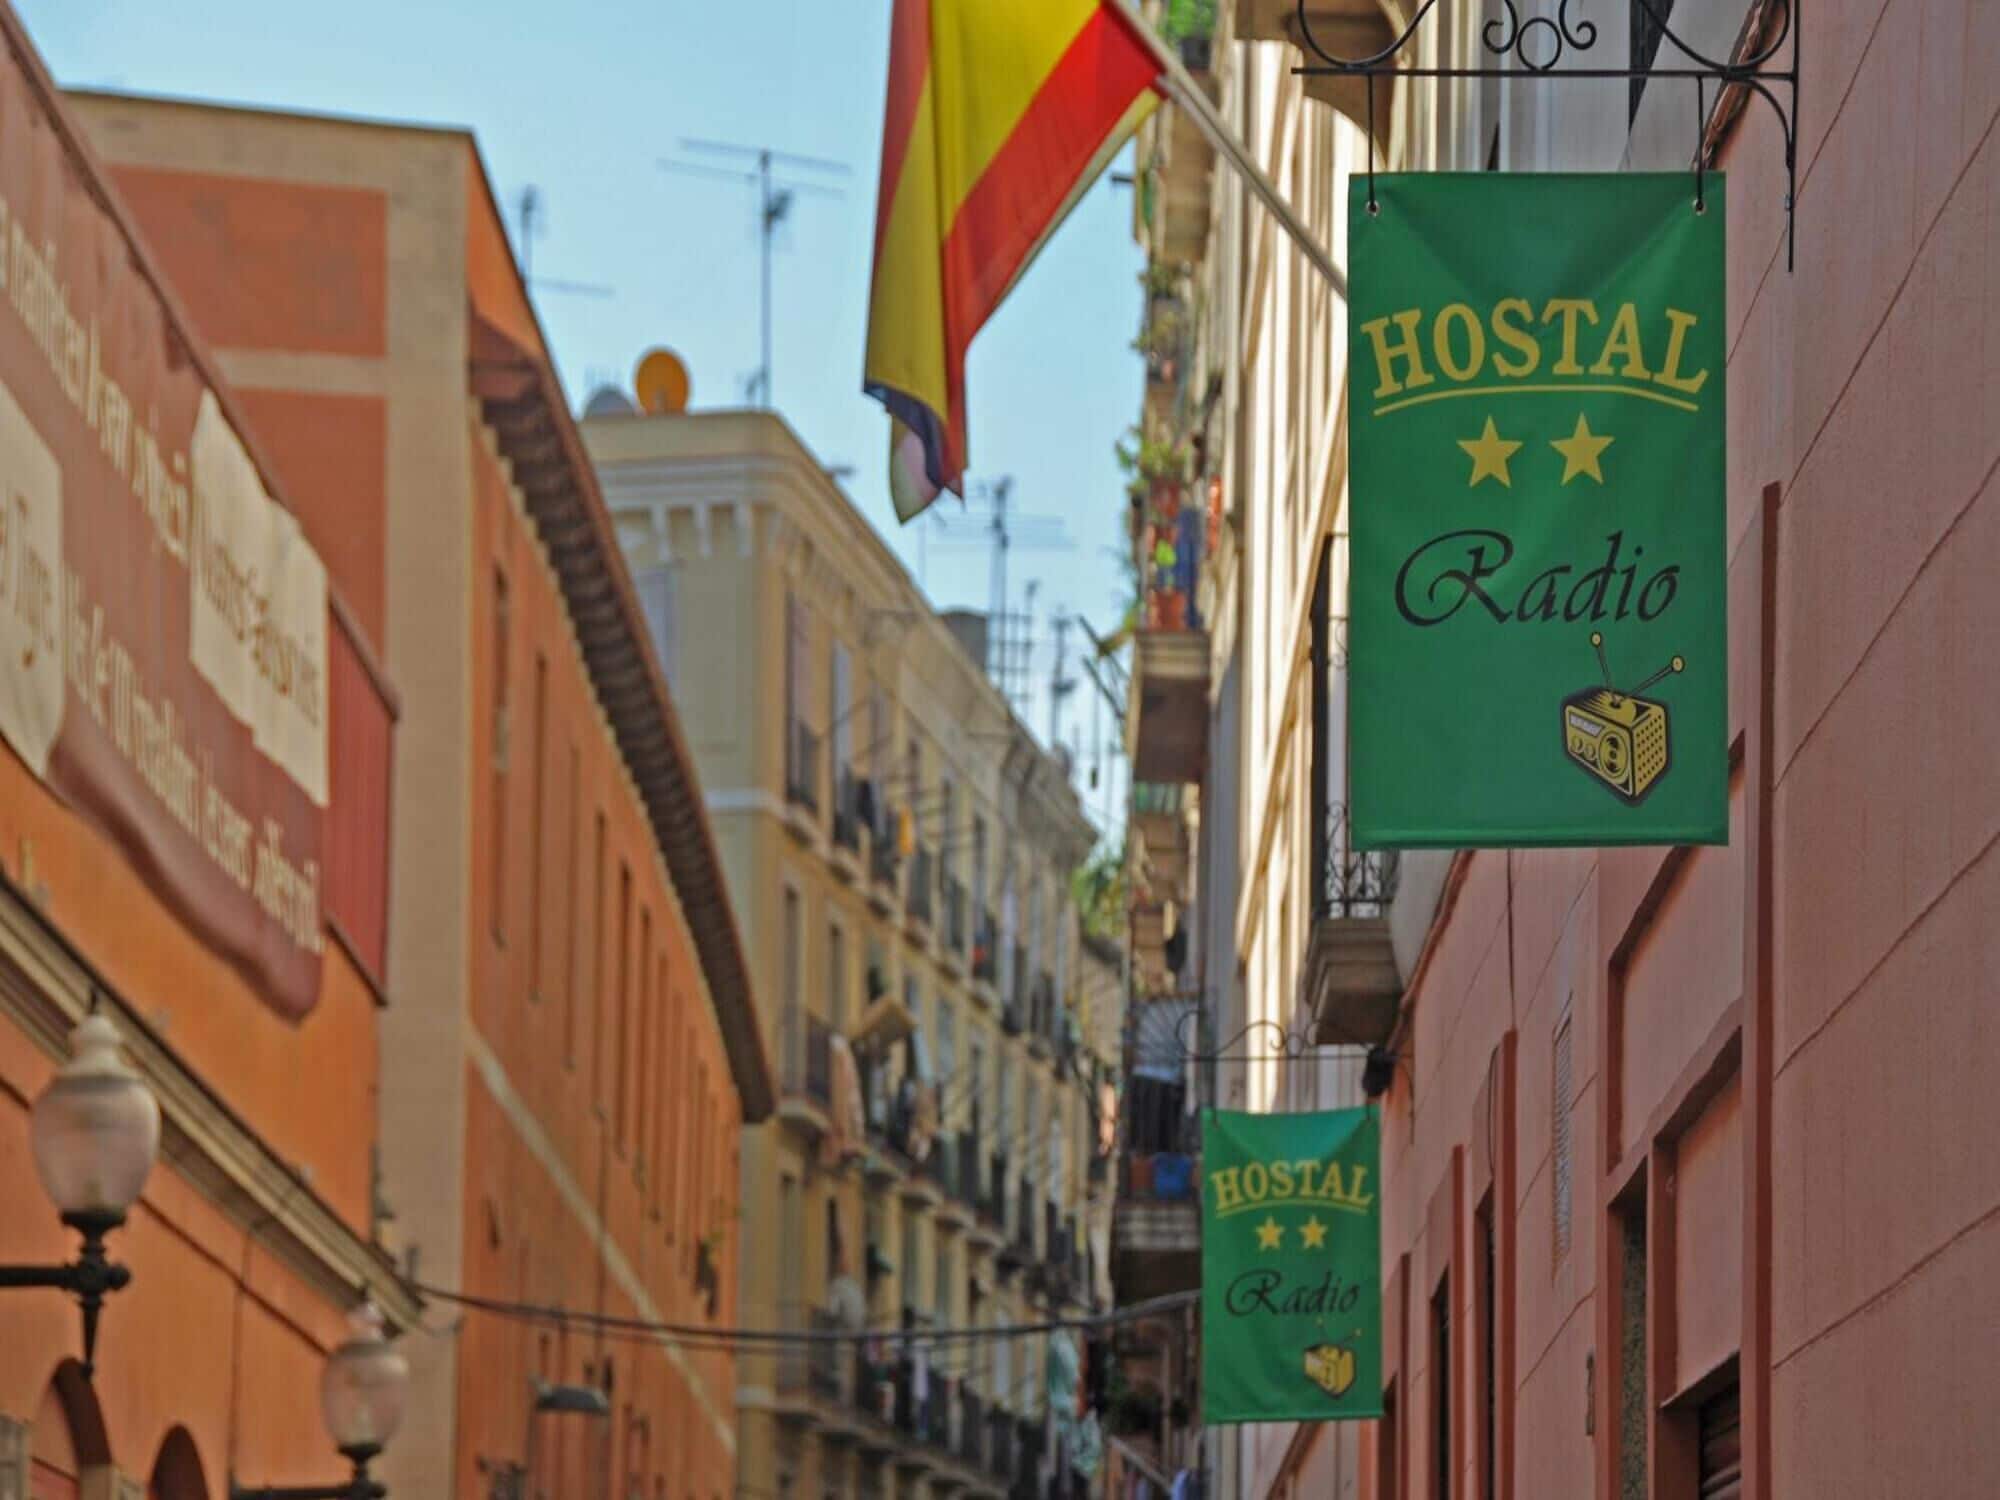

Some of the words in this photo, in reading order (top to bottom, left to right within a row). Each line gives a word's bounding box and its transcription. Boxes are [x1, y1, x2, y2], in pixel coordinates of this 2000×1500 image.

[1360, 297, 1709, 399] HOSTAL
[1394, 529, 1680, 627] Radio
[1210, 1159, 1374, 1211] HOSTAL
[1225, 1268, 1361, 1318] Radio
